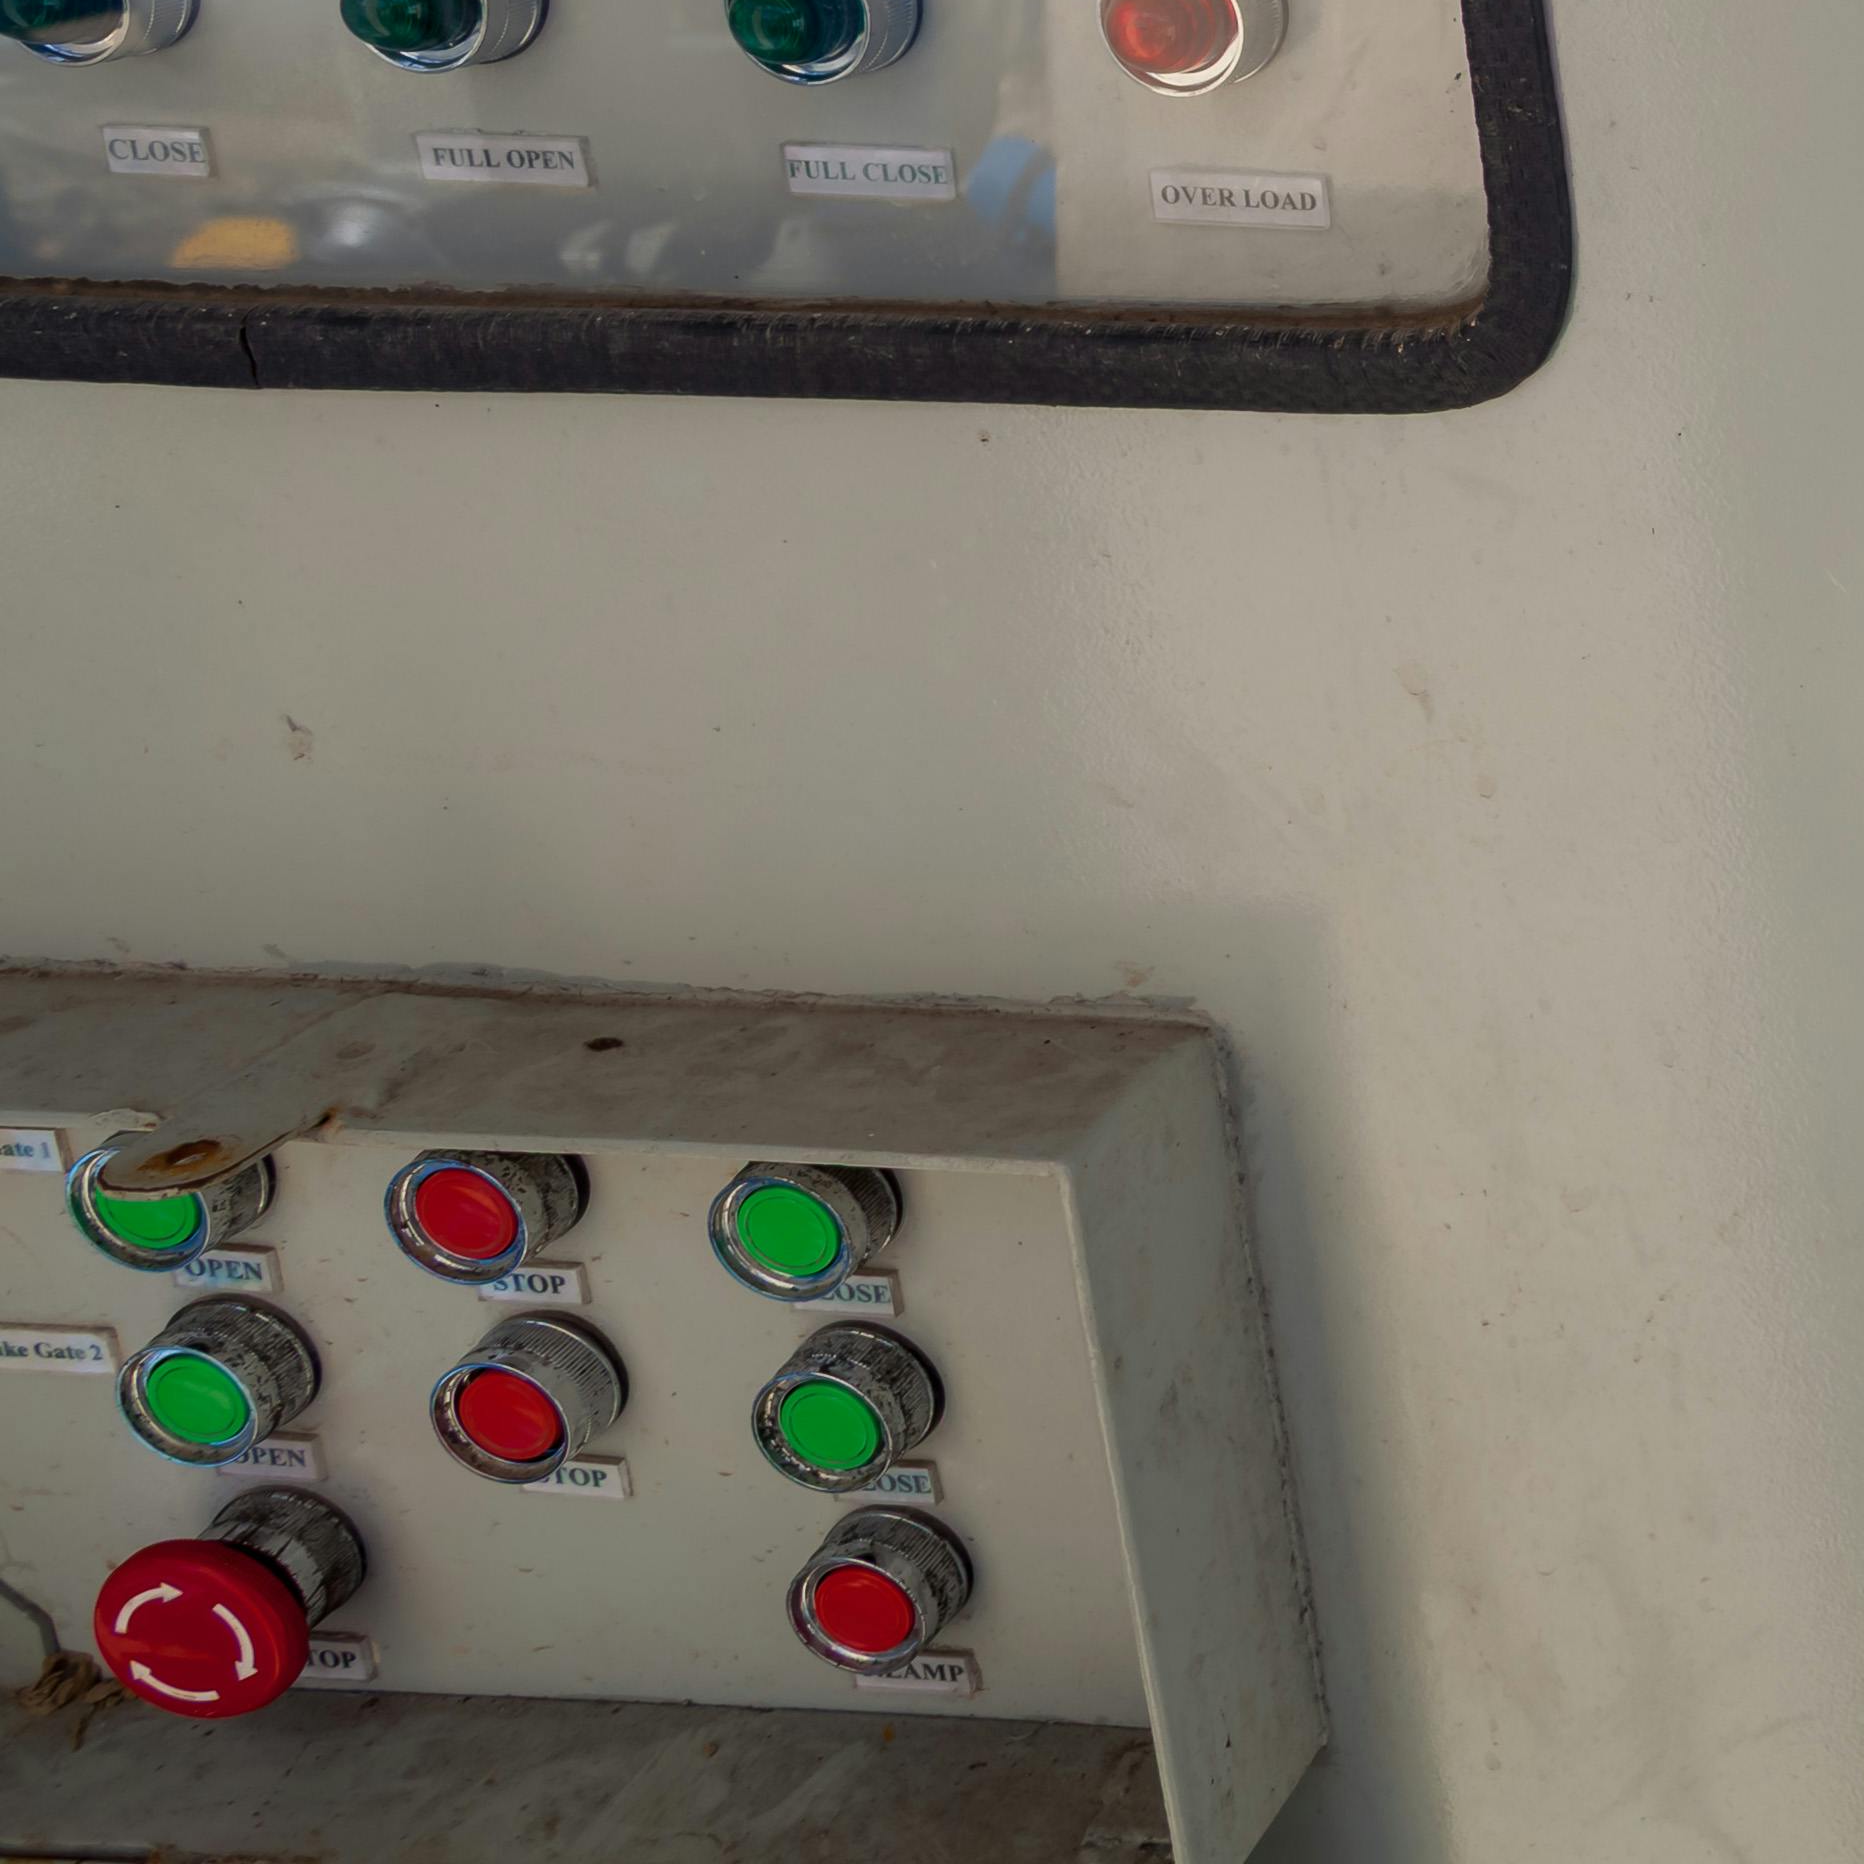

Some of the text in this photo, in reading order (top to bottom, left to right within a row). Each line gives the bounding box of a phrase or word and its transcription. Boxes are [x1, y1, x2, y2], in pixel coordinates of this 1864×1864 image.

[108, 138, 206, 163] CLOSE
[432, 148, 576, 172] FULL OPEN
[788, 159, 948, 186] FULL CLOSE
[1161, 185, 1318, 213] OVER LOAD
[0, 1142, 51, 1159] ate 1
[184, 1257, 263, 1281] OPEN
[493, 1273, 566, 1294] STOP
[821, 1283, 891, 1304] OSE
[33, 1342, 87, 1360] Gate
[89, 1344, 103, 1361] 2
[540, 1467, 608, 1488] TOP
[862, 1474, 932, 1494] OSE
